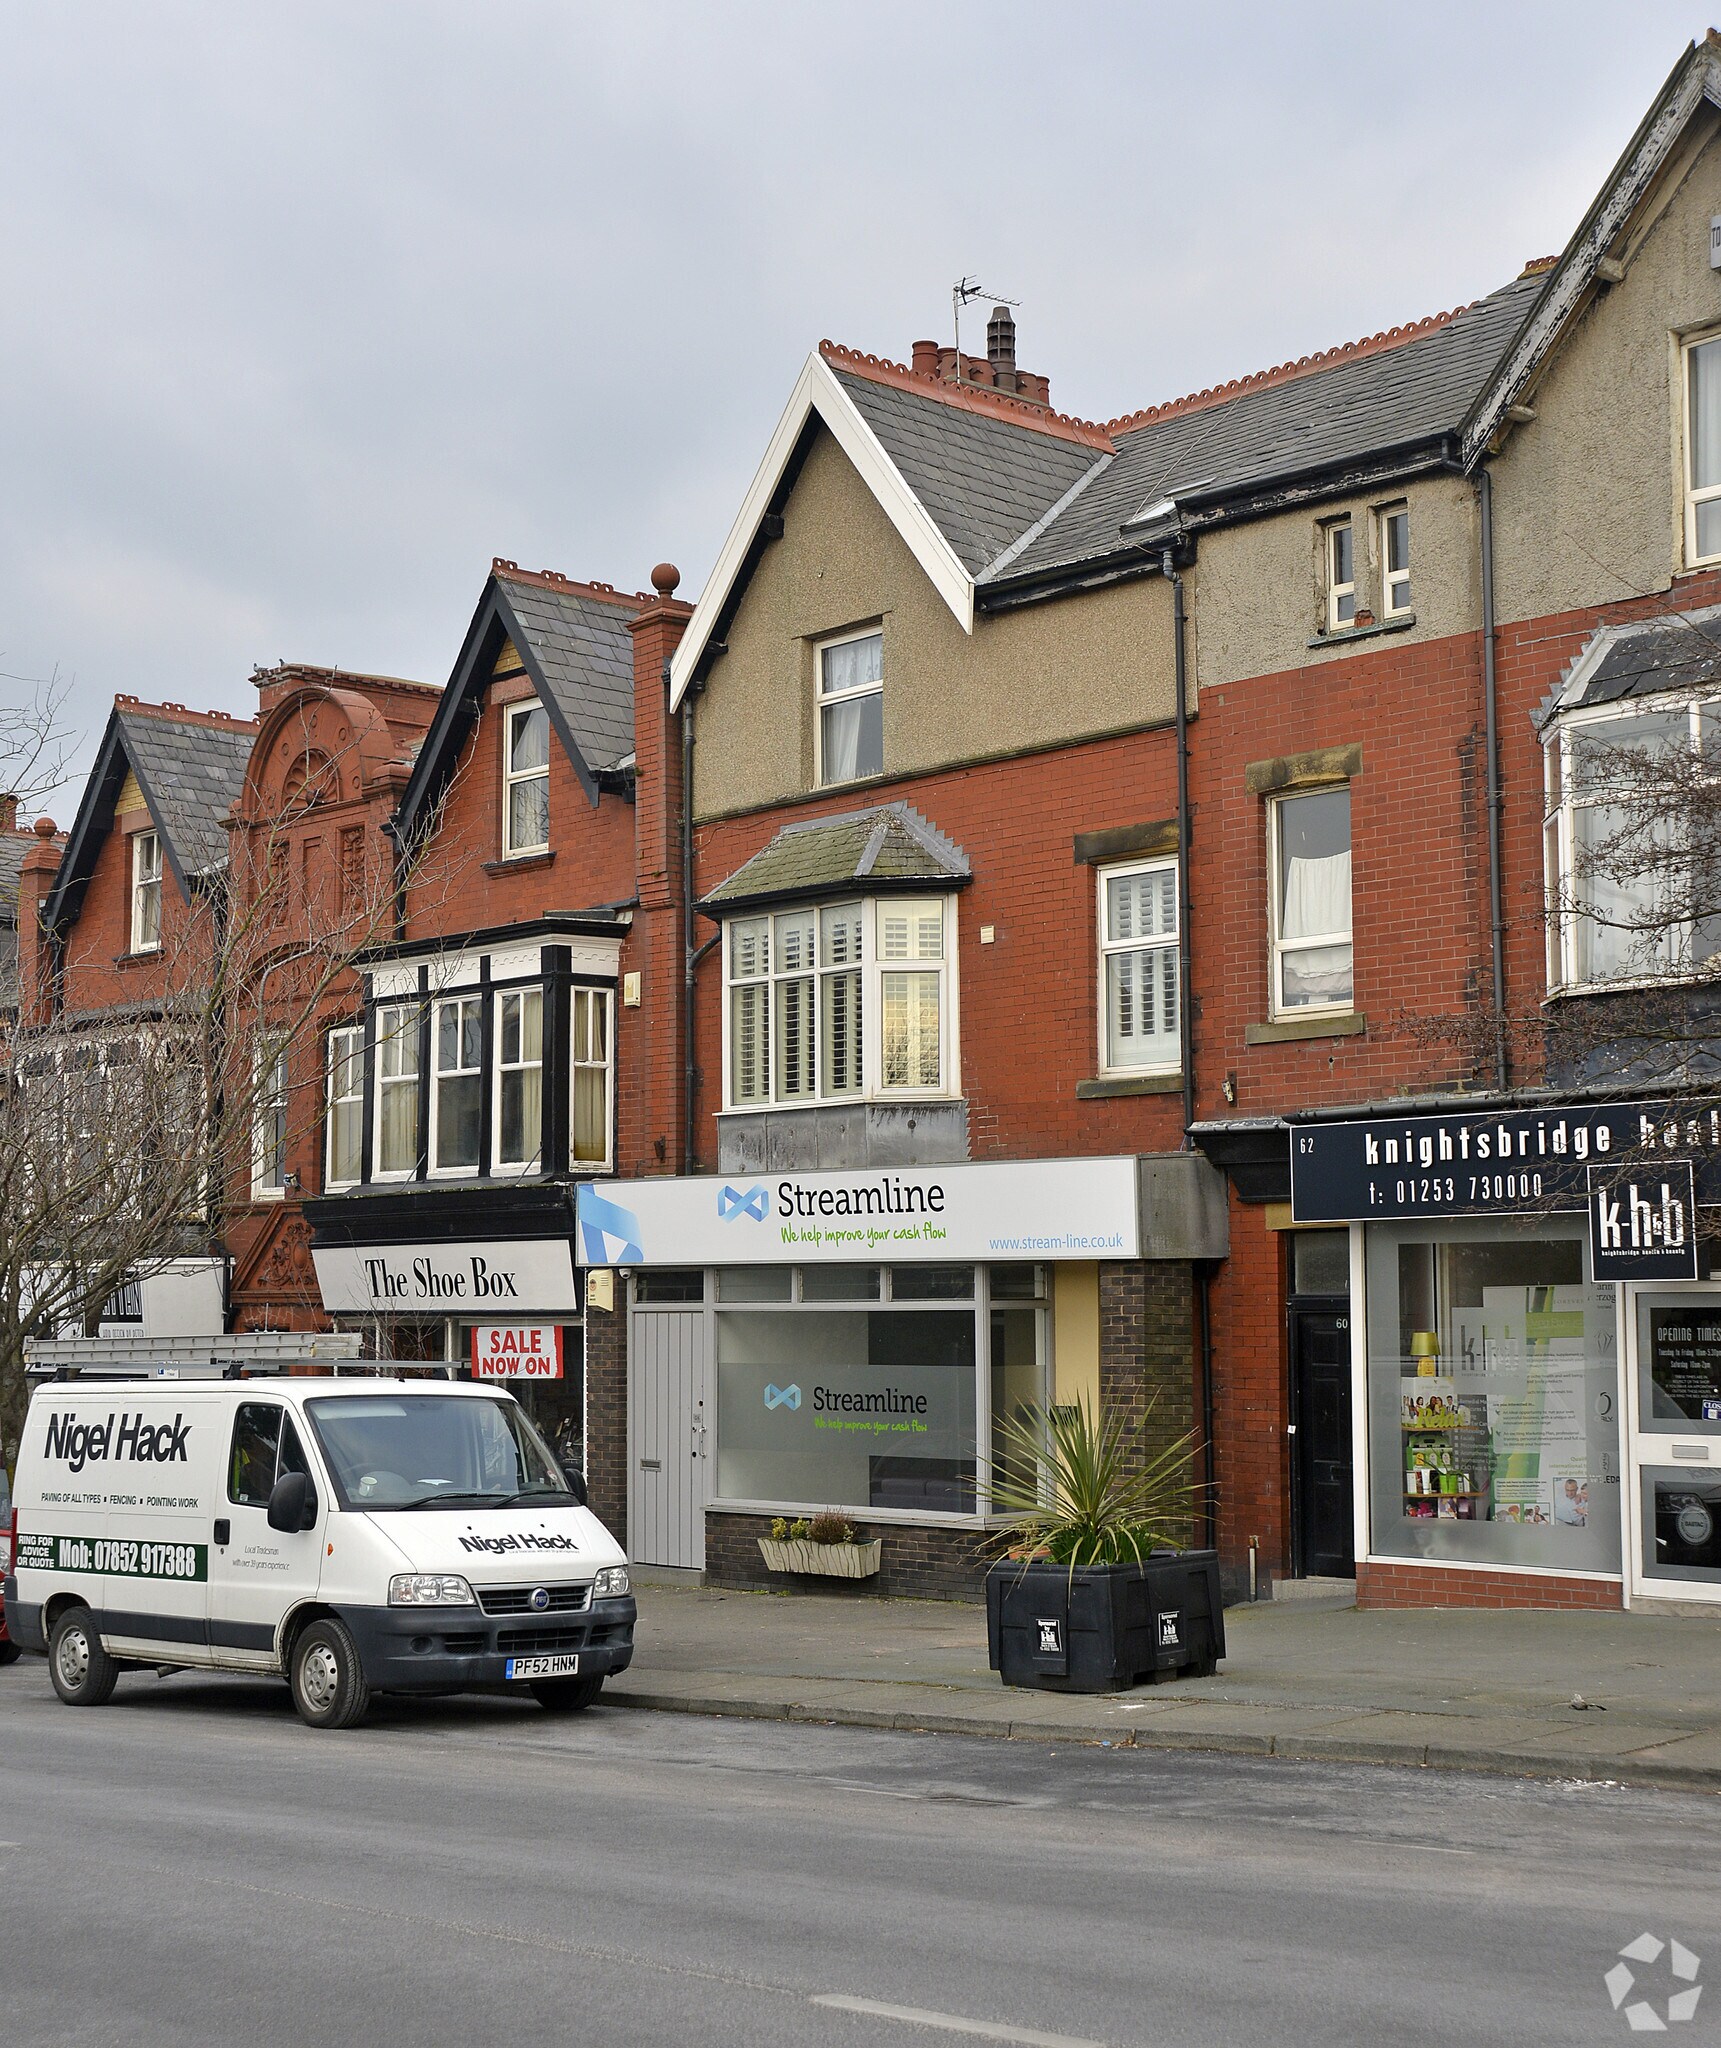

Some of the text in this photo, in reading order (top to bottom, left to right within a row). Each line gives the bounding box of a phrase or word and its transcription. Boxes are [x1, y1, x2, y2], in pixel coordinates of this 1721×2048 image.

[1300, 1137, 1314, 1154] 62
[1365, 1120, 1611, 1168] knightsbridge
[778, 1177, 945, 1217] Streamline
[1370, 1173, 1542, 1204] t: 01253 730000
[781, 1221, 947, 1248] We help improve your cash flow
[989, 1232, 1123, 1250] www.stream-line.co.uk
[365, 1256, 519, 1298] The Shoe Box
[1336, 1318, 1348, 1329] 60
[490, 1330, 541, 1354] SALE
[1657, 1327, 1721, 1341] OPENING TIMES
[483, 1357, 550, 1375] NOW ON
[813, 1386, 927, 1414] Streamline
[814, 1414, 928, 1436] We help improve your cash flow
[44, 1413, 193, 1473] Nigel Hack
[41, 1492, 101, 1504] PAVING OF ALL TYPES
[109, 1495, 137, 1505] FENCING
[147, 1496, 198, 1508] POINTING WORK
[18, 1535, 53, 1547] RING FOR
[458, 1534, 579, 1554] Nigel Hack
[22, 1546, 49, 1557] ADVICE
[59, 1539, 196, 1577] Mob: 07852 917388
[17, 1557, 54, 1568] OR QUOTE
[515, 1656, 576, 1675] PF52 HNM
